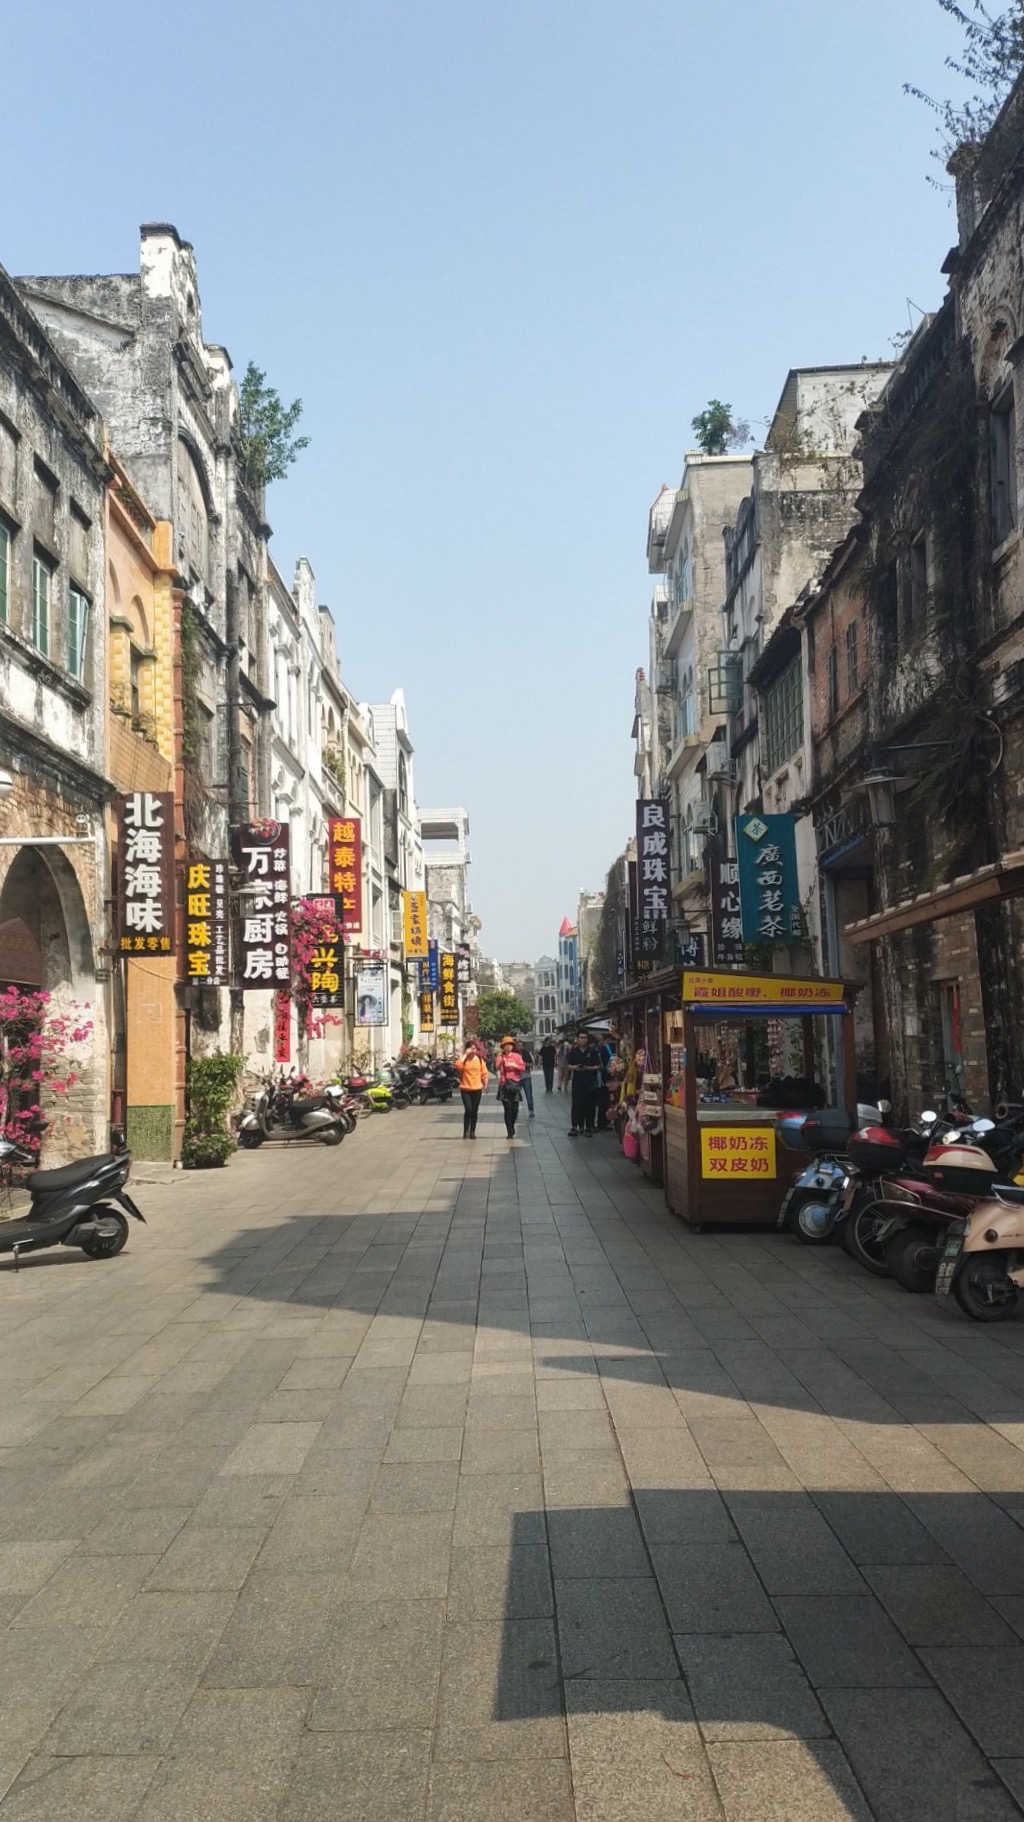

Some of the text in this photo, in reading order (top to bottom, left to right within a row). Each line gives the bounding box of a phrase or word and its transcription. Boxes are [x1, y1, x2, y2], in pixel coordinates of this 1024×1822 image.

[749, 822, 763, 836] 茶
[123, 792, 164, 933] 北海海味
[642, 804, 668, 909] 良成珠宝
[241, 846, 274, 980] 万家厨房
[273, 879, 288, 904] 海鲜
[720, 863, 742, 939] 顺心缘
[754, 843, 787, 938] 廣西茗茶
[120, 936, 171, 950] 批发零售
[187, 863, 212, 976] 庆旺珠宝
[274, 910, 288, 936] 火锅
[442, 954, 455, 1008] 海鲜食街
[708, 1136, 768, 1151] 椰奶冻
[709, 1157, 769, 1172] 双皮奶
